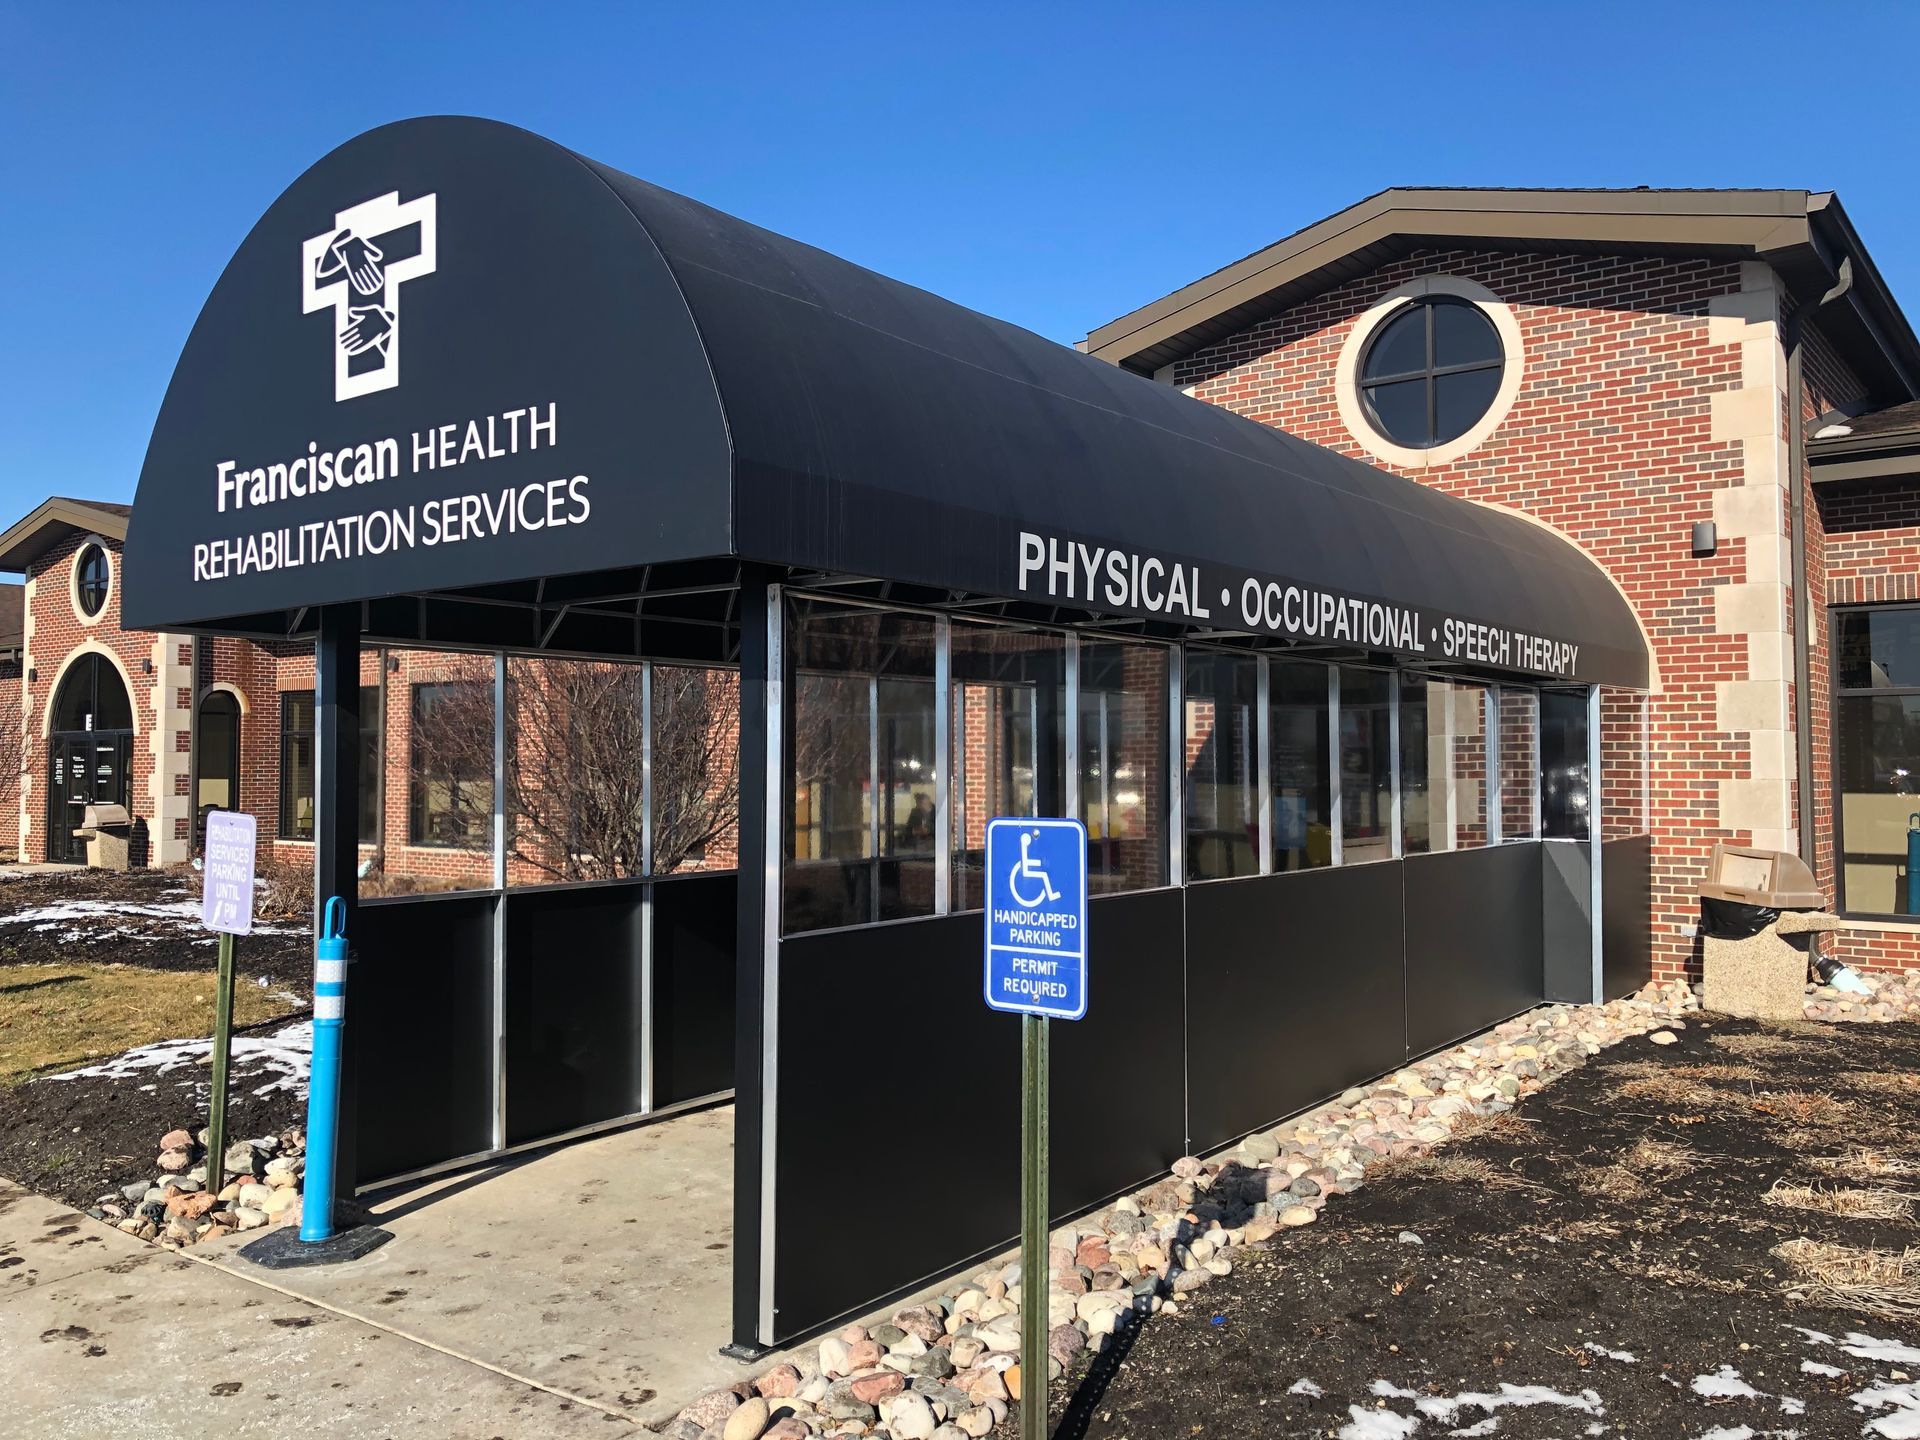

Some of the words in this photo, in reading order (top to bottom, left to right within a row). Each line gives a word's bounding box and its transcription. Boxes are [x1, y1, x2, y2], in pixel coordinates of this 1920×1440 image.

[217, 437, 399, 512] Franciscan
[411, 402, 557, 473] HEALTH
[193, 505, 415, 581] REHABILITATION
[421, 475, 591, 546] SERVICES
[1018, 532, 1210, 619] PHYSICAL
[1241, 577, 1425, 652] OCCUPATIONAL
[1443, 618, 1510, 665] SPEECH
[1515, 632, 1579, 676] THERAPY
[210, 844, 250, 864] SERVICES
[211, 863, 247, 882] PARKING
[215, 882, 240, 901] UNTIL
[223, 902, 237, 919] PM
[994, 909, 1077, 929] HANDICAPPED
[1010, 928, 1061, 946] PARKING
[1012, 958, 1058, 976] PERMIT
[1003, 977, 1067, 998] REQUIRED
